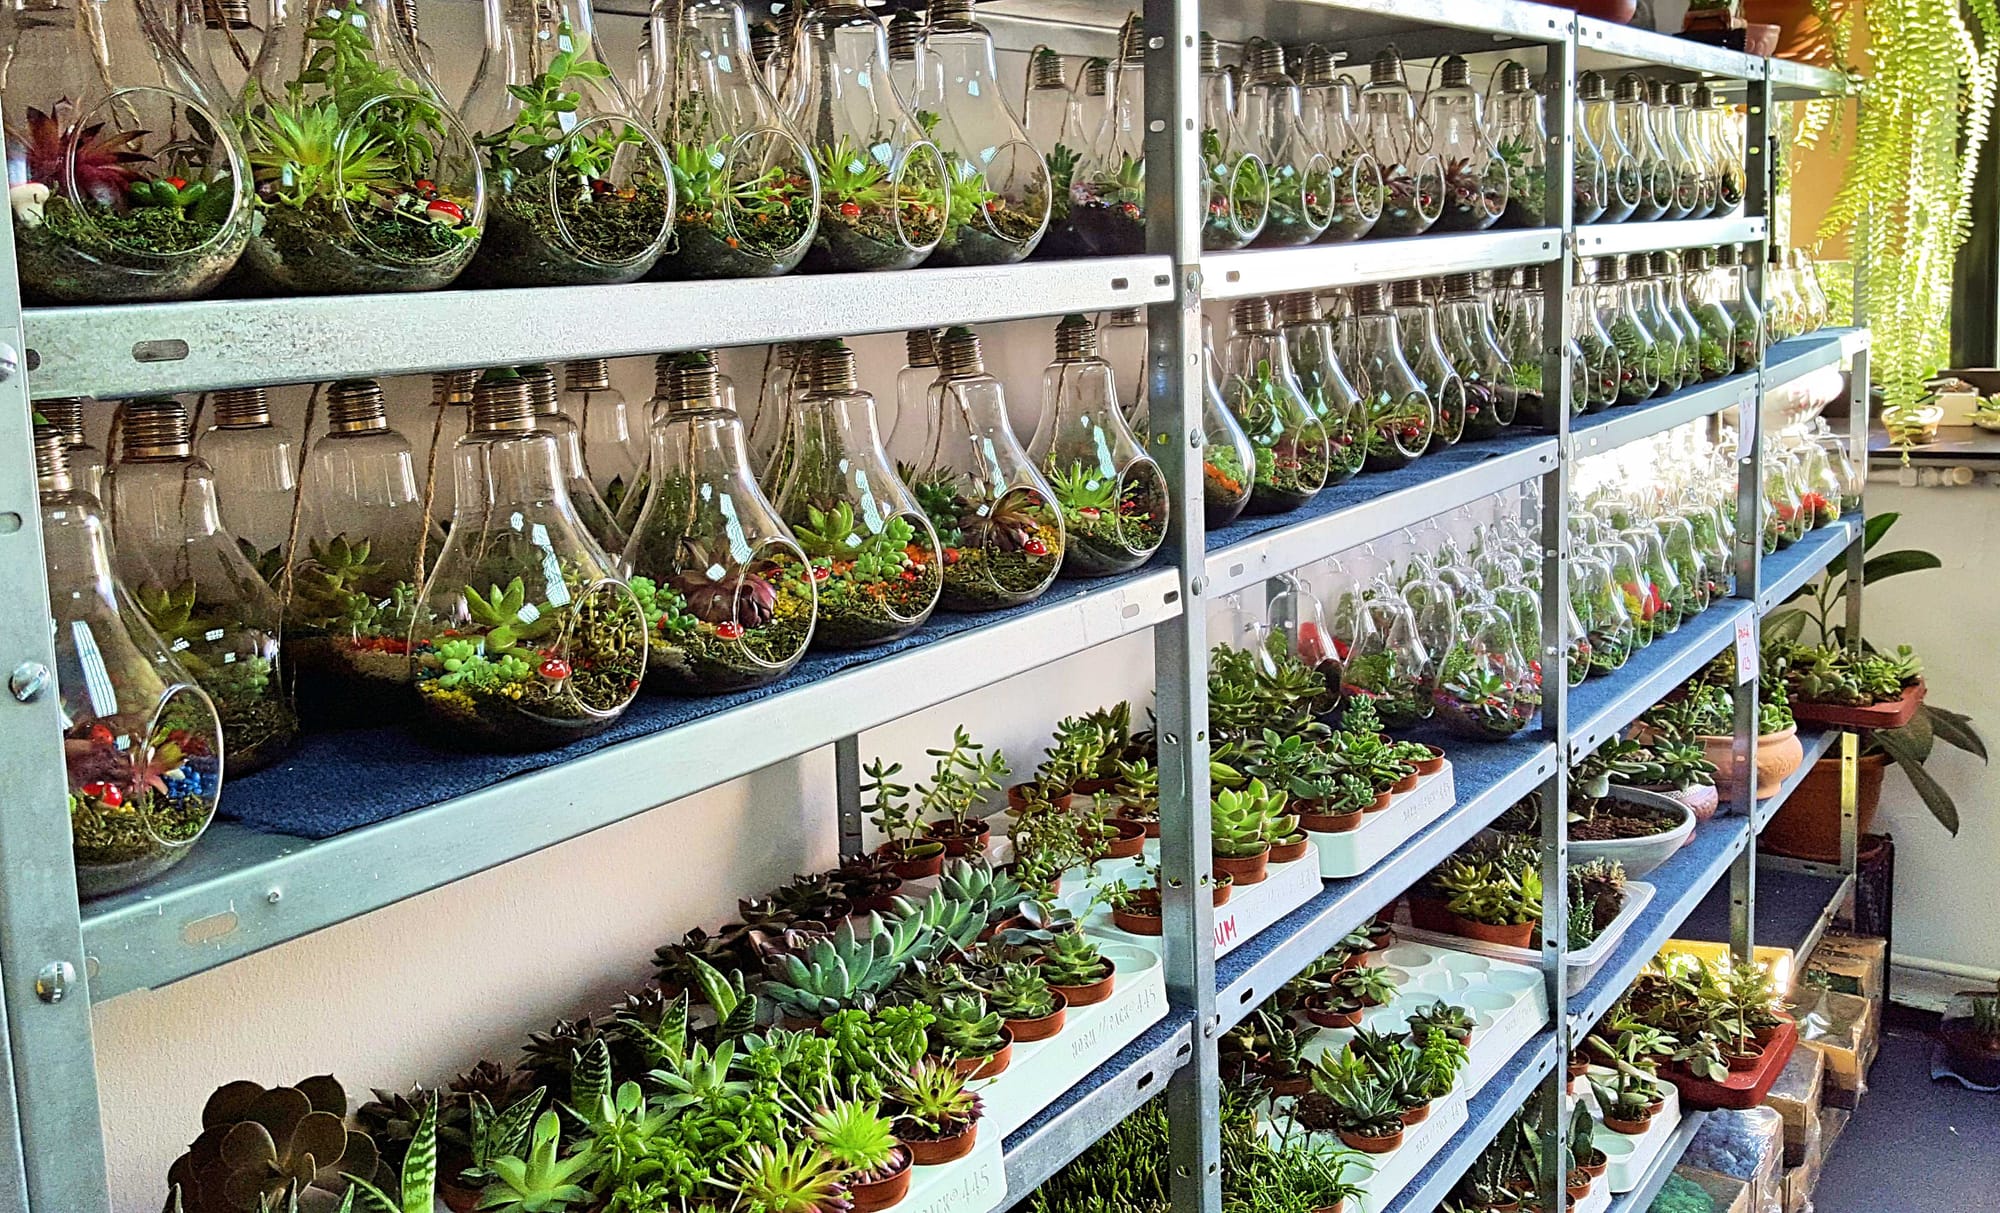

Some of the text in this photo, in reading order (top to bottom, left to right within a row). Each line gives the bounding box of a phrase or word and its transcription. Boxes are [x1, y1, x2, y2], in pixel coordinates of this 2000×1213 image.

[1213, 914, 1238, 948] UM
[1135, 983, 1157, 1014] 445
[962, 1163, 991, 1206] 445
